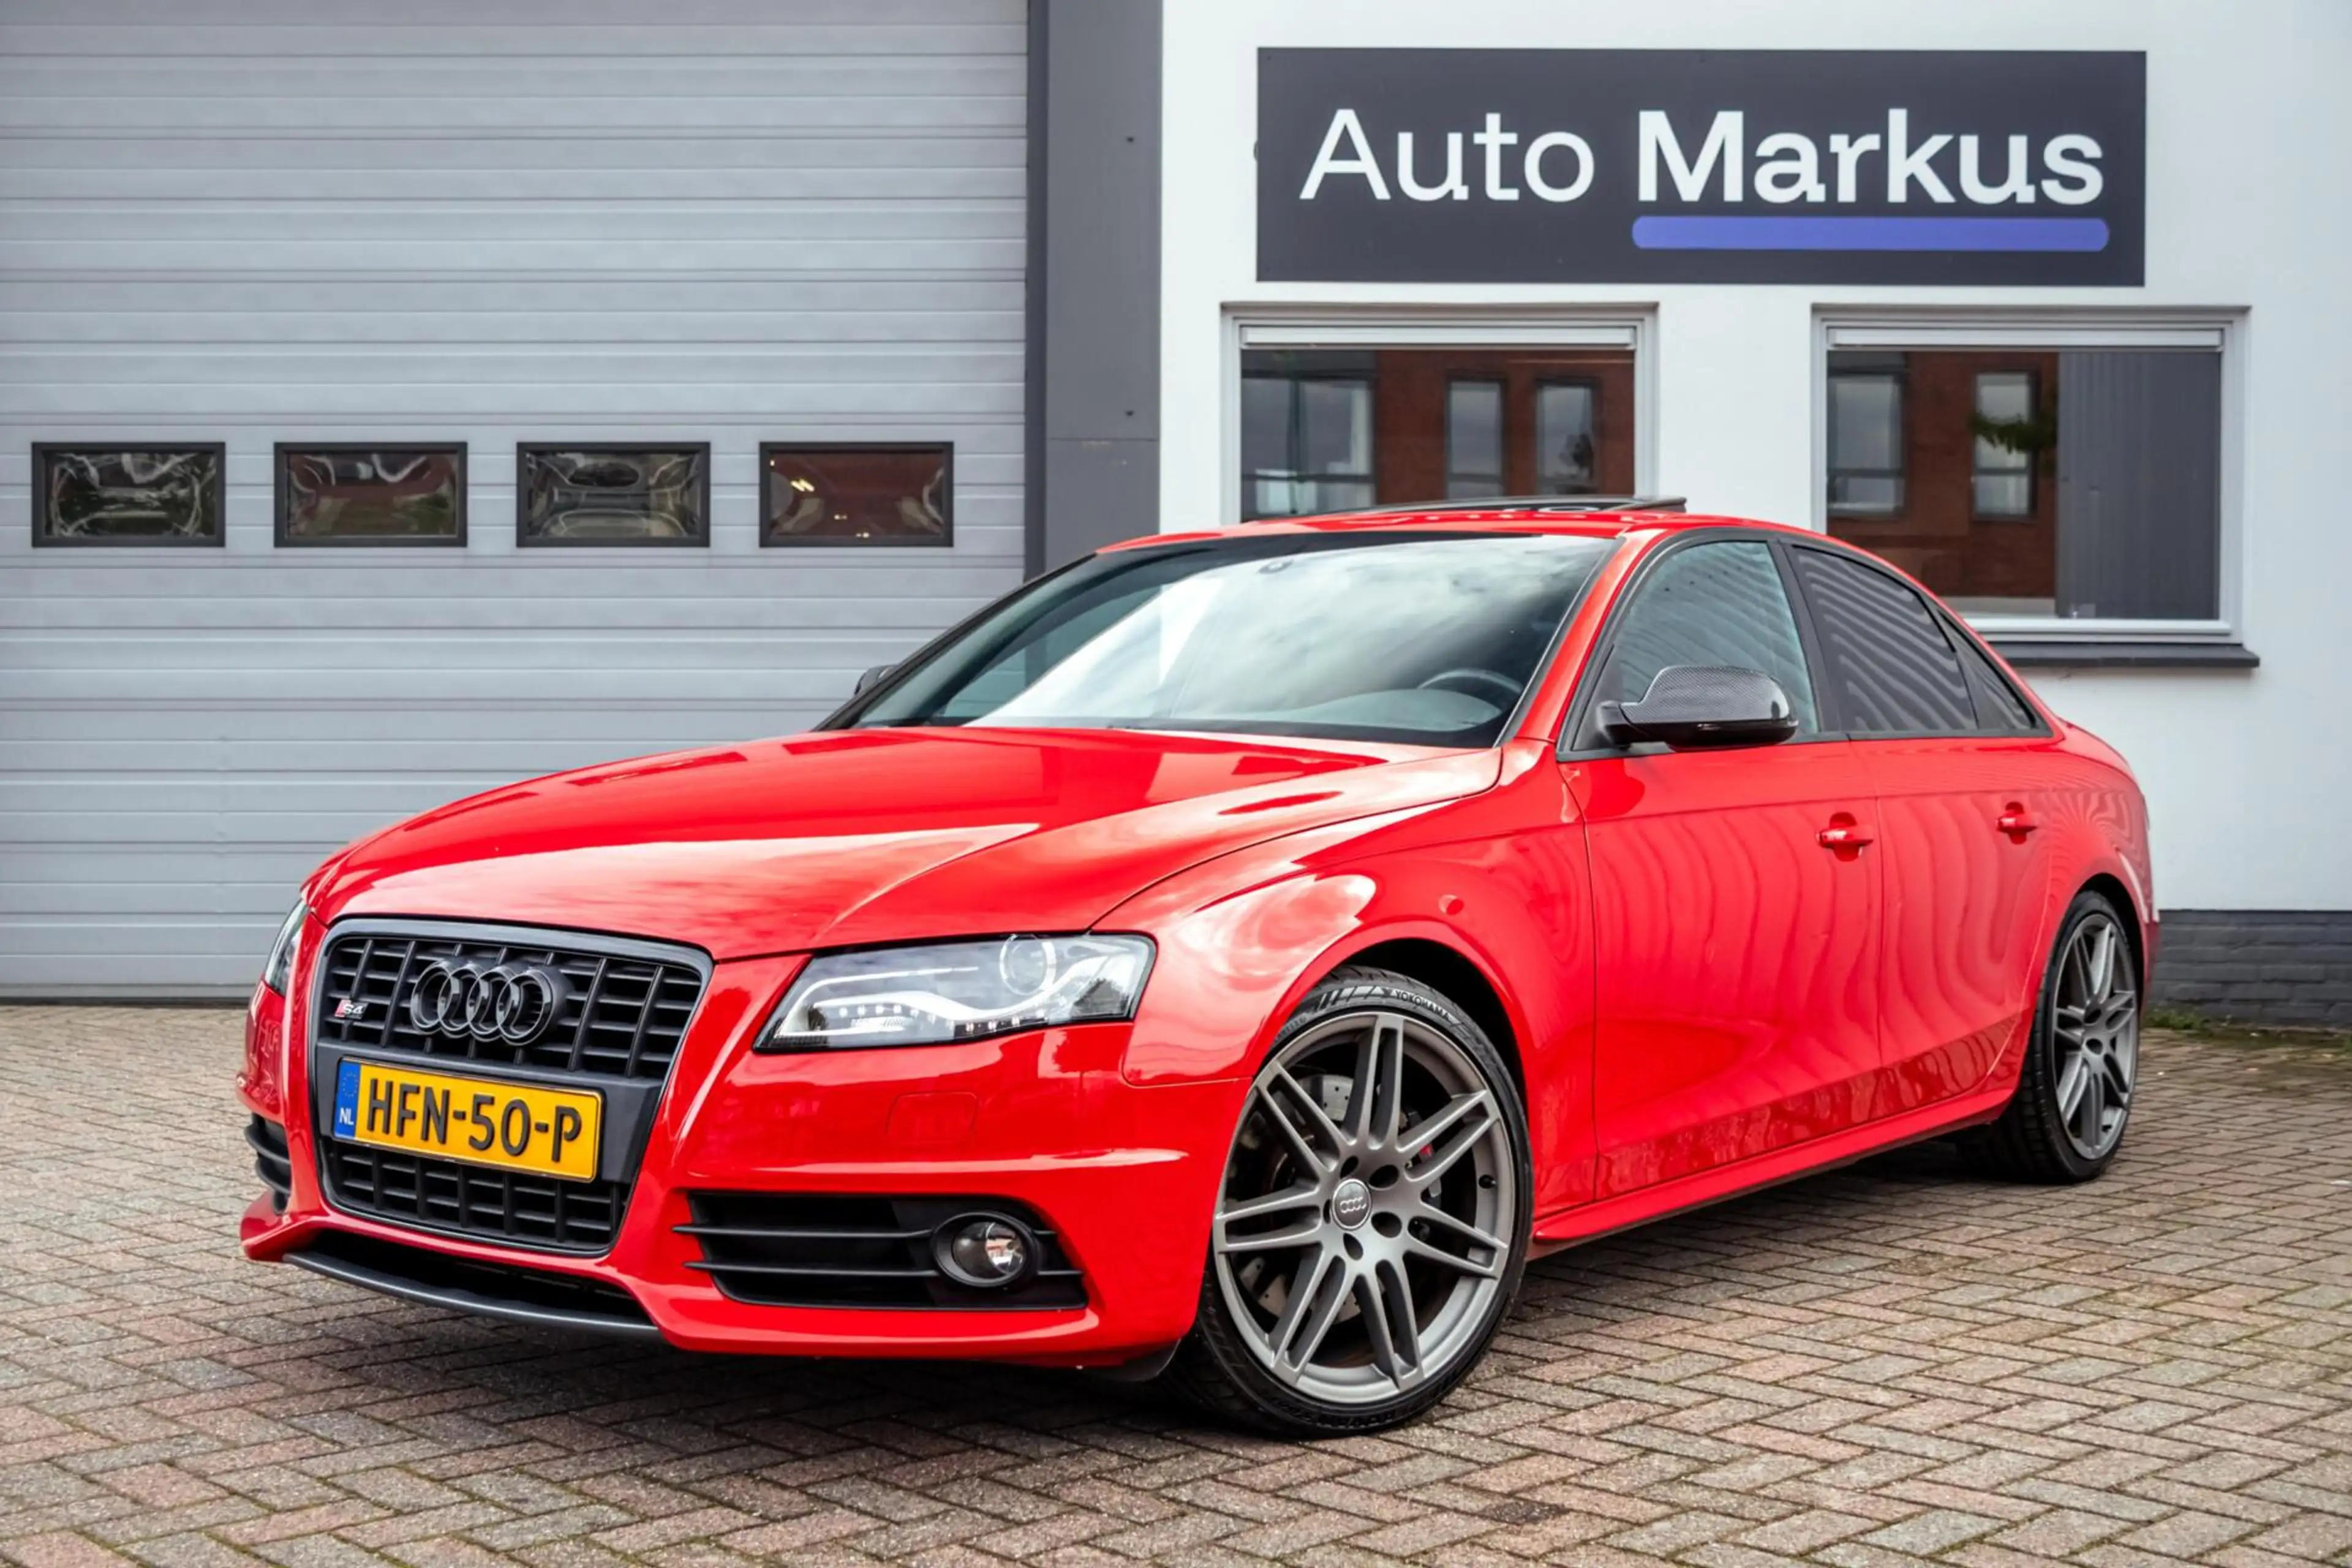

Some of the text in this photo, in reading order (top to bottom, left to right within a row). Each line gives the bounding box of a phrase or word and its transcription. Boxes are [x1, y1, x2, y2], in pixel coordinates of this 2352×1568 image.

[1300, 108, 2104, 205] Auto Markus
[1395, 990, 1451, 1023] YOKOHAMA
[339, 1107, 355, 1126] NL
[367, 1078, 582, 1163] HFN-50-P
